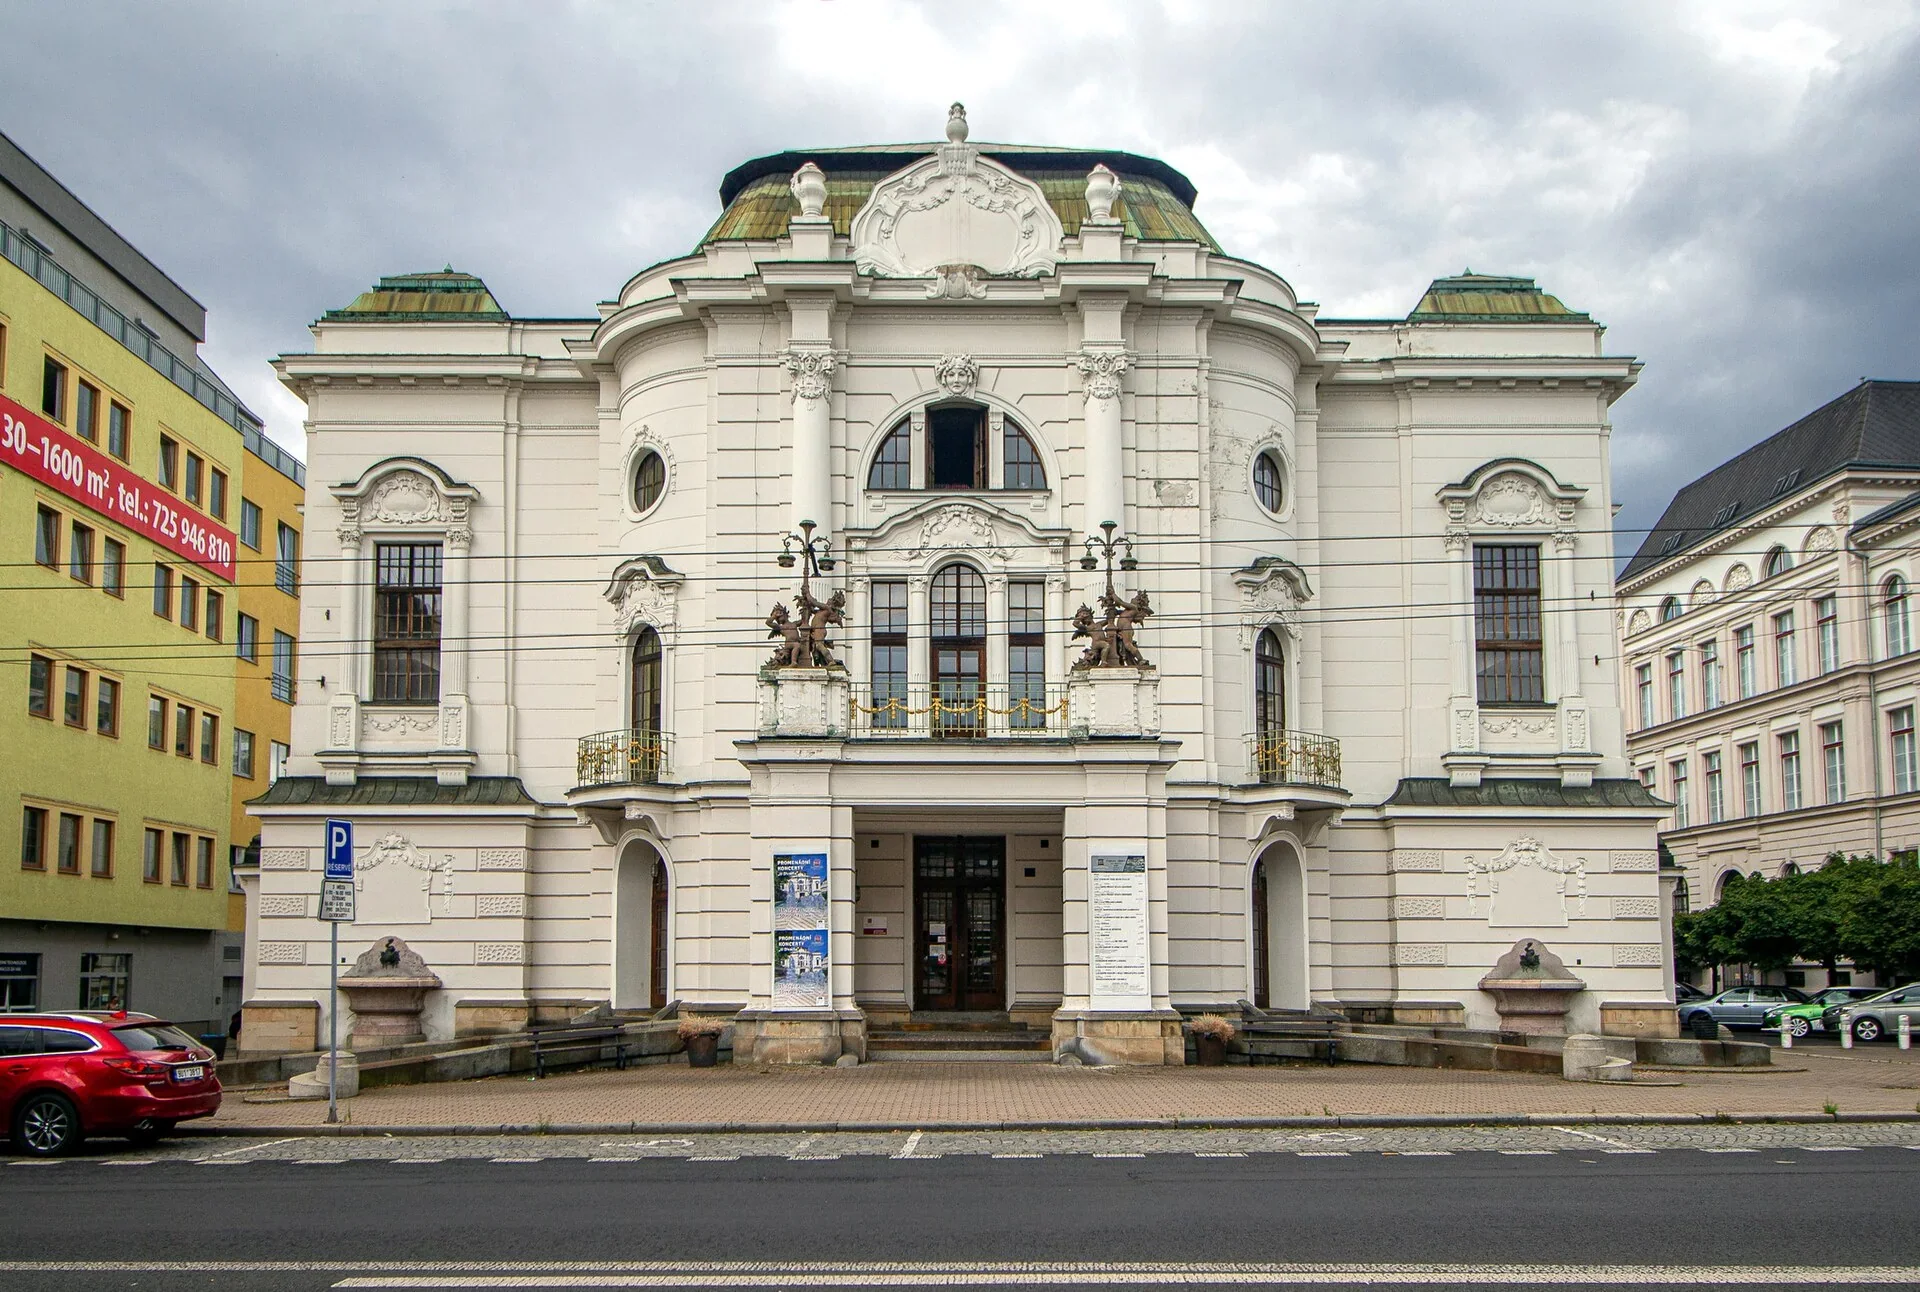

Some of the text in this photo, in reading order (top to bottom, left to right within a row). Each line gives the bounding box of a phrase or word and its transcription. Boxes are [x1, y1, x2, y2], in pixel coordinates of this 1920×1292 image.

[118, 483, 148, 524] tel.:
[152, 499, 177, 538] 725
[181, 517, 206, 554] 946
[208, 533, 231, 568] 810
[331, 827, 347, 859] P
